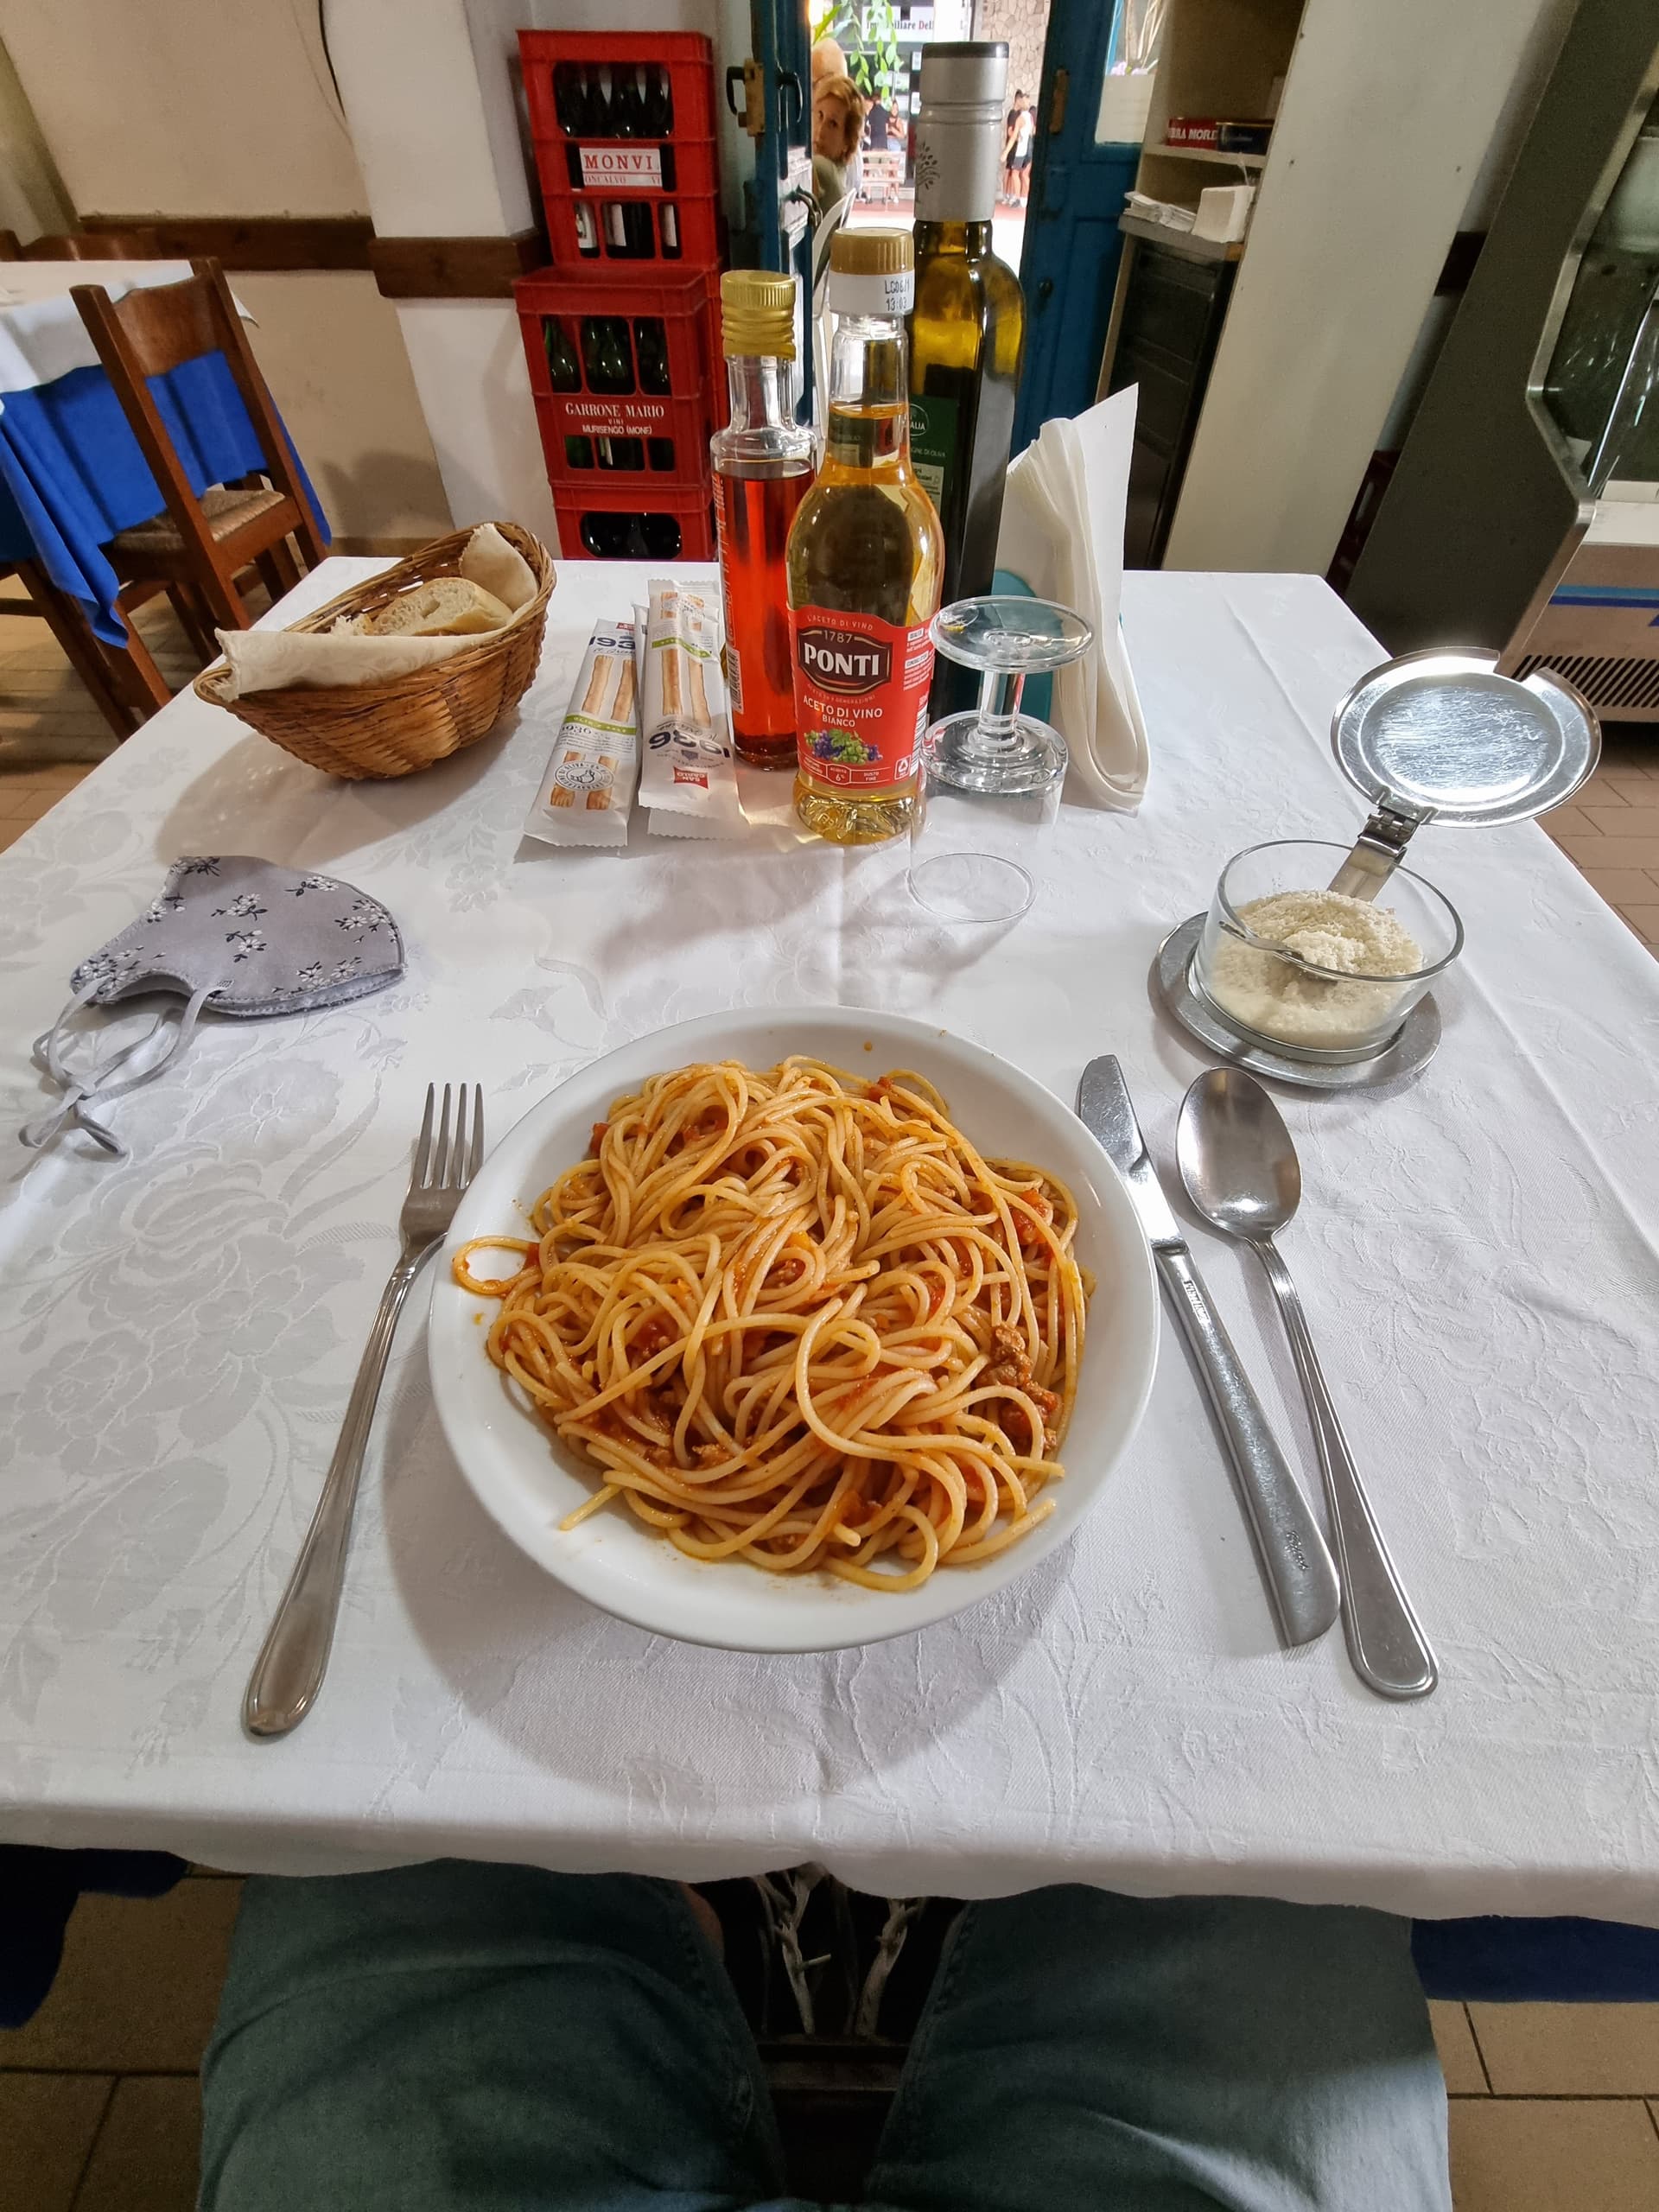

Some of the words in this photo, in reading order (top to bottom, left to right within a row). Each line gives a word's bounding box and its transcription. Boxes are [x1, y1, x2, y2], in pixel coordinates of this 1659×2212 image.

[867, 20, 916, 29] Imiliare
[584, 155, 652, 169] MONVI
[565, 403, 620, 416] GARRONE
[626, 404, 664, 417] MARIO
[852, 621, 874, 631] VINO
[823, 630, 853, 644] 1787
[804, 643, 880, 677] PONTI
[803, 695, 835, 715] ACETO
[836, 708, 849, 718] DI
[853, 708, 883, 719] VINO
[822, 715, 856, 728] BIANCO
